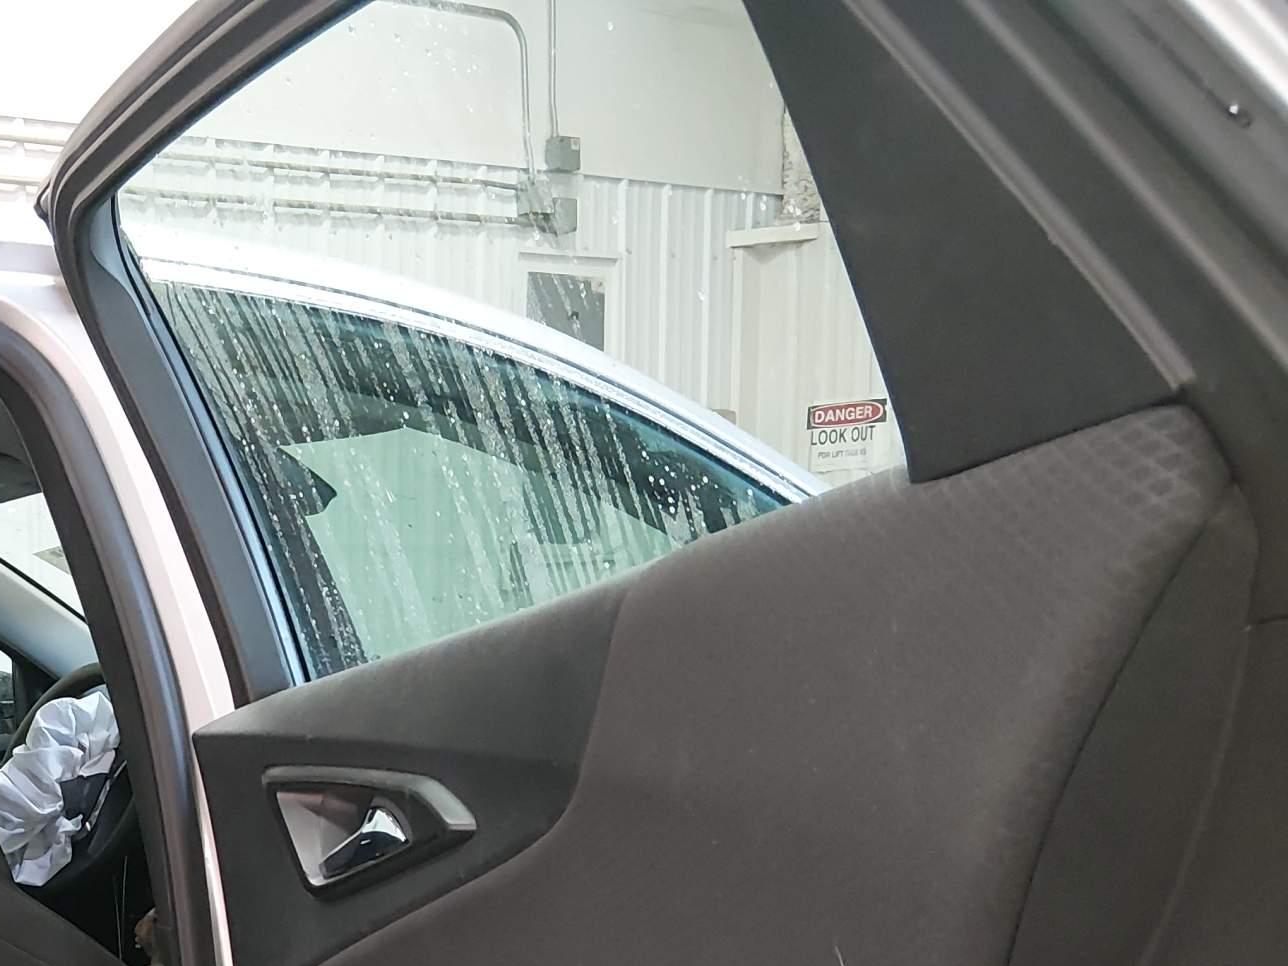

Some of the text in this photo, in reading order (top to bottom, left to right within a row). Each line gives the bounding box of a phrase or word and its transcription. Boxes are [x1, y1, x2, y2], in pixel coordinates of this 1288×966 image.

[814, 404, 873, 423] DANGER
[810, 425, 876, 446] LOOK OUT
